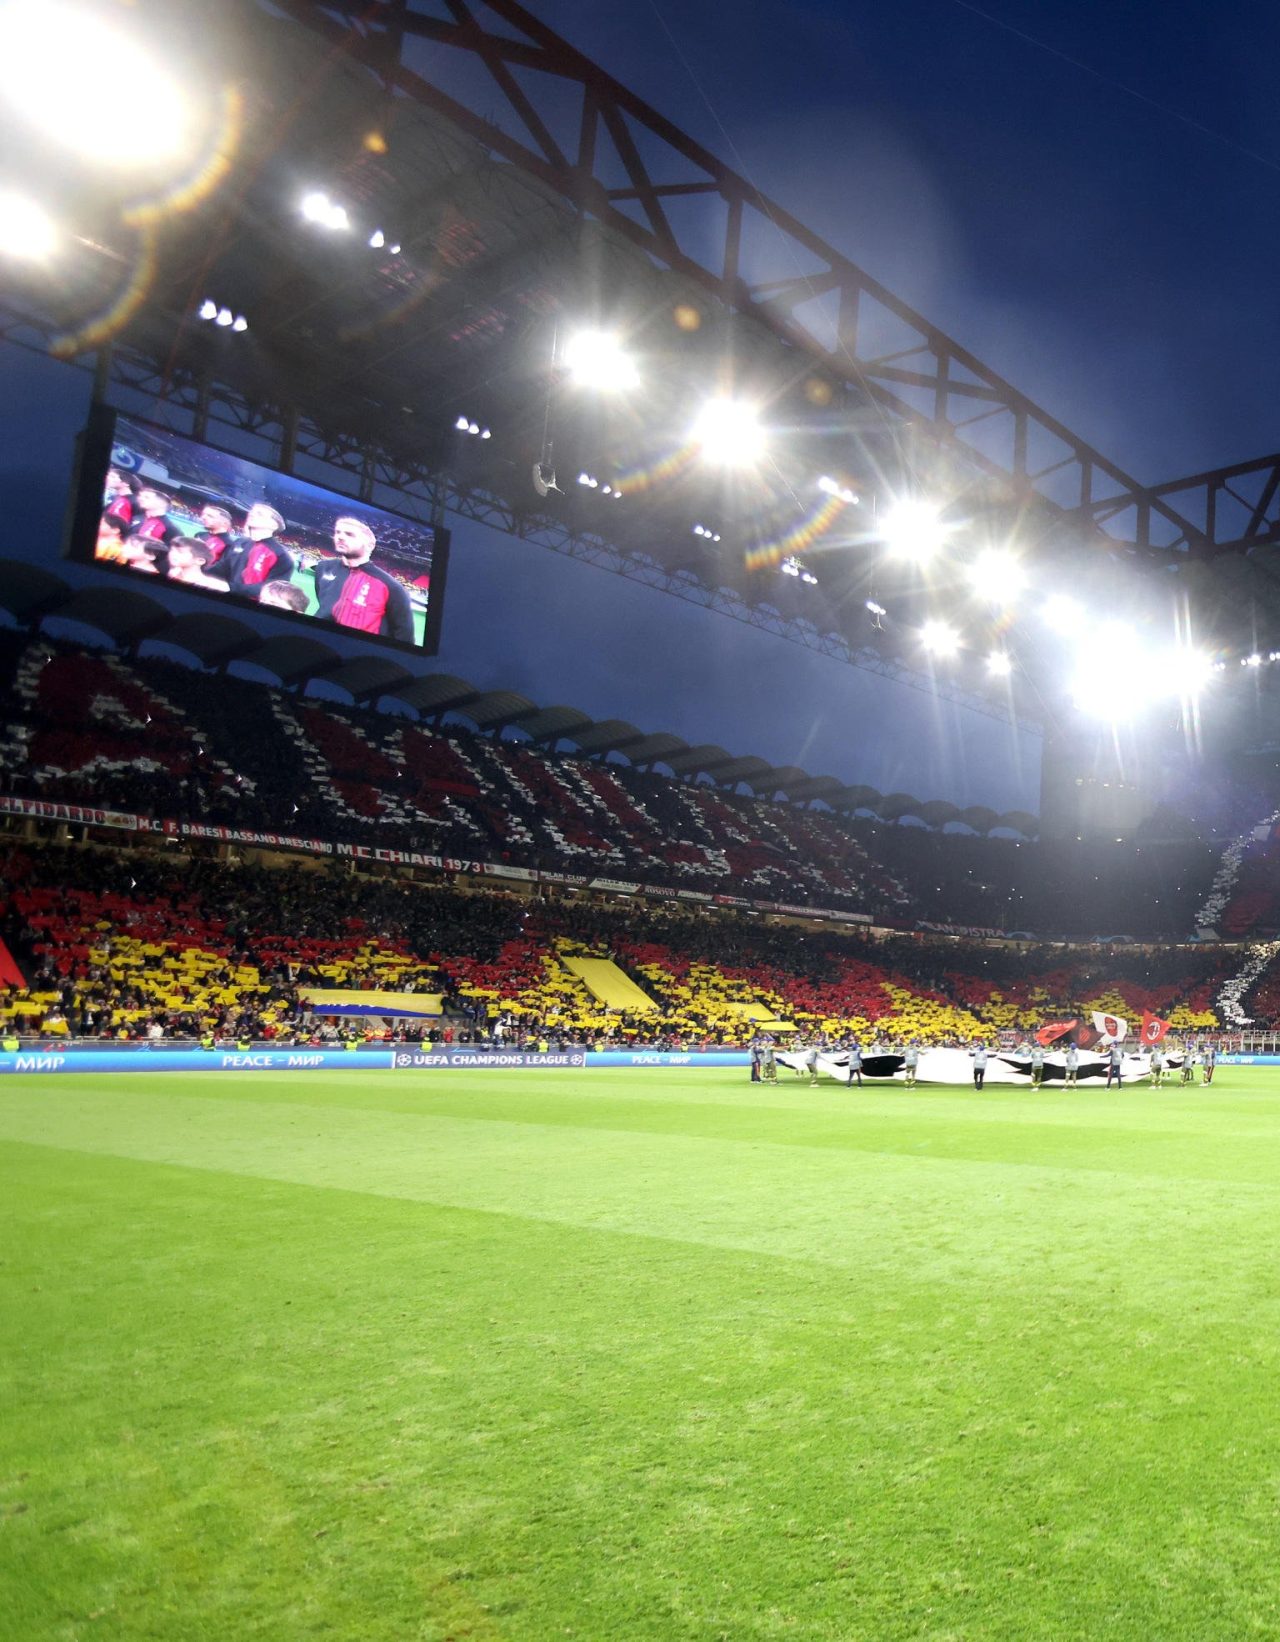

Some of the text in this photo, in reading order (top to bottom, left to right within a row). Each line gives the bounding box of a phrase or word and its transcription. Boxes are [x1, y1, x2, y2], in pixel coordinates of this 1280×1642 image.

[182, 823, 224, 838] BARESI
[225, 829, 277, 844] BASSANO
[278, 836, 333, 854] BRESCIANO
[447, 858, 481, 873] 1973
[223, 1055, 273, 1066] PEACE
[414, 1055, 569, 1065] UEFA CHAMPIONS LEAGUE
[632, 1055, 661, 1064] PEACE
